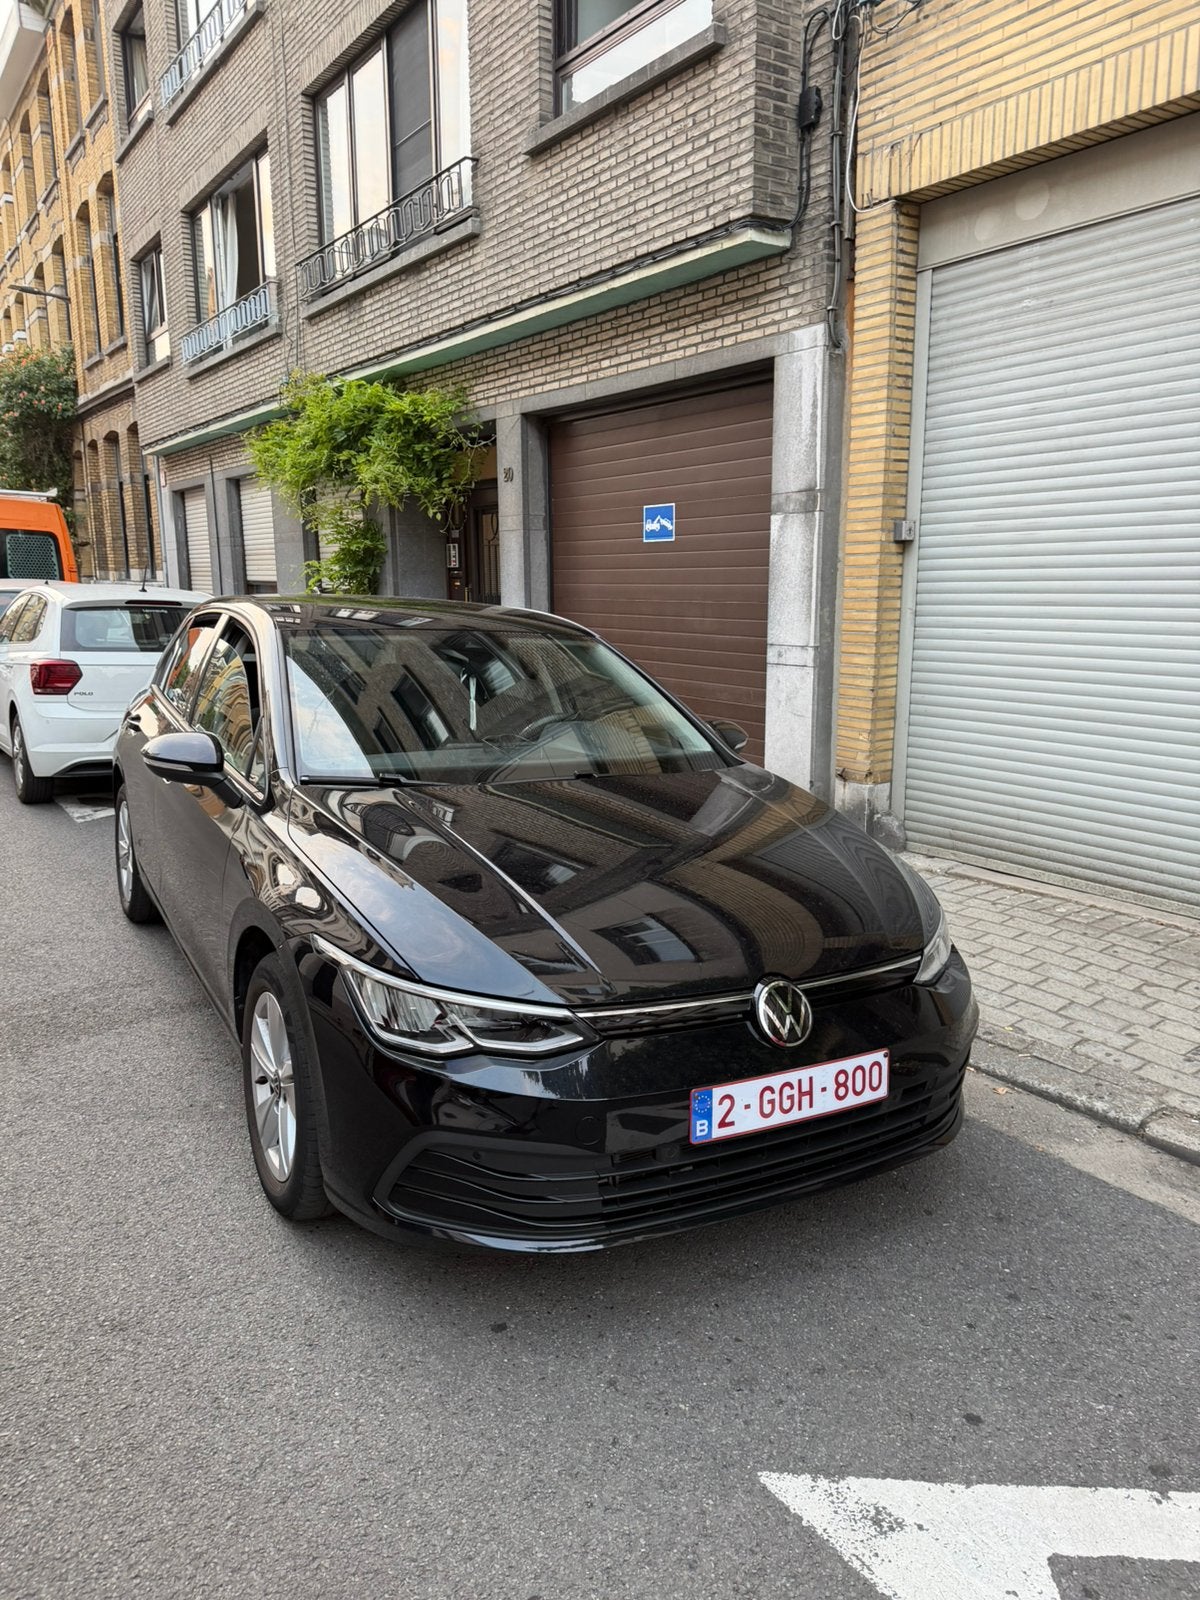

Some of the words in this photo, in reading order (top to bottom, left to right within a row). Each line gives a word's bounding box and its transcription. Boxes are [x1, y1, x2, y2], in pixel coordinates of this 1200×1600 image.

[757, 980, 813, 1047] VW
[696, 1119, 709, 1137] B
[717, 1060, 883, 1130] 2-GGH-800
